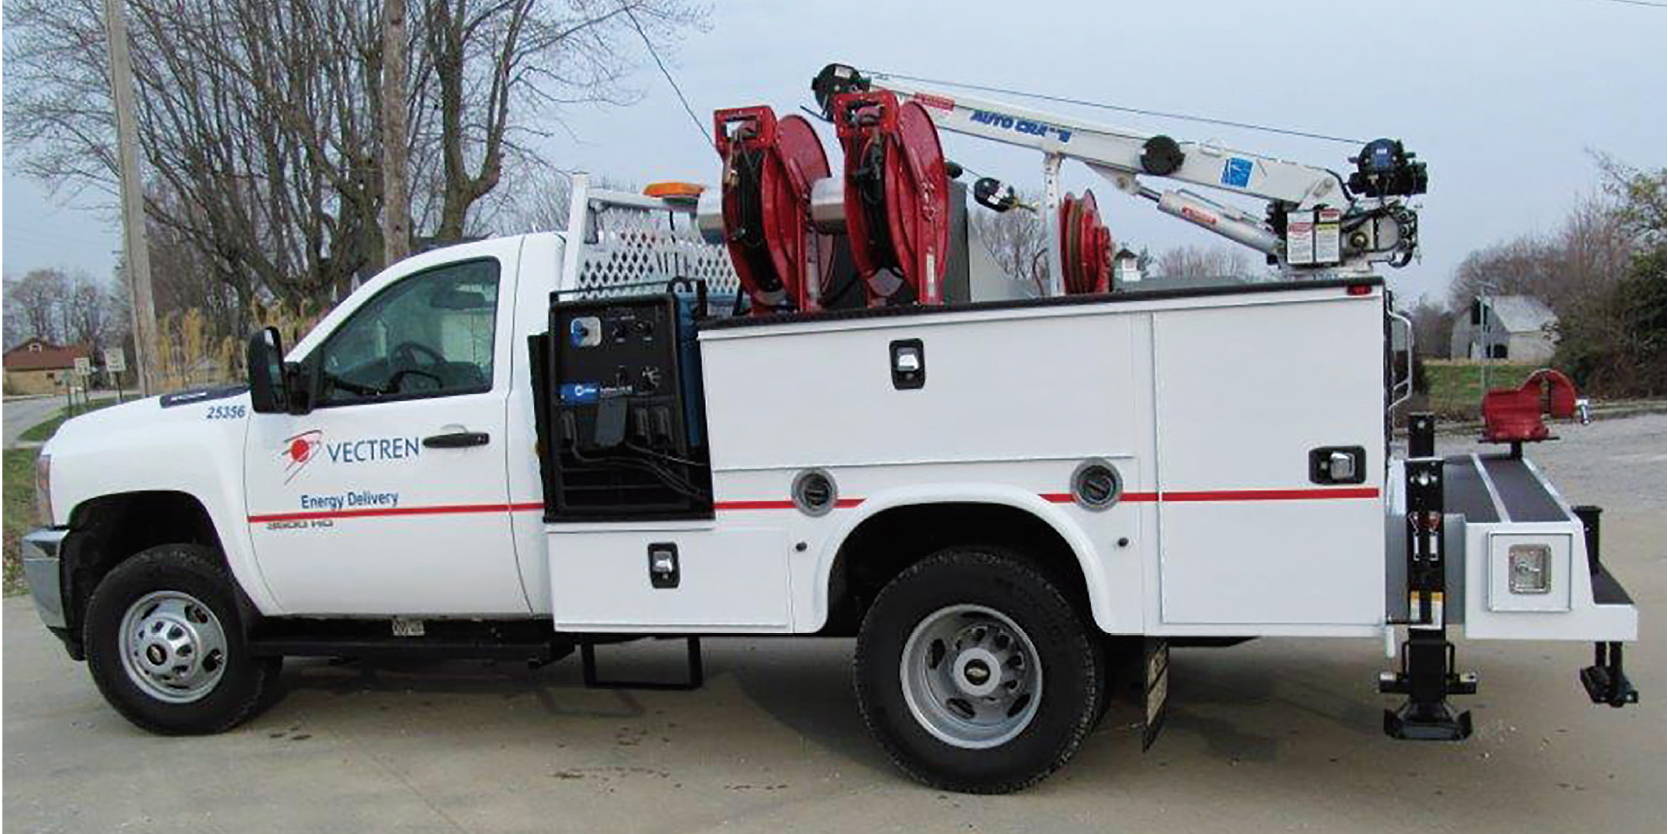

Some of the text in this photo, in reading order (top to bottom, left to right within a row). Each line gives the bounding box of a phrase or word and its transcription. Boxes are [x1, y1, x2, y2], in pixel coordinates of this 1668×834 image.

[206, 405, 246, 419] 25356
[327, 437, 419, 462] VECTREN
[301, 491, 399, 512] Energy Delivery
